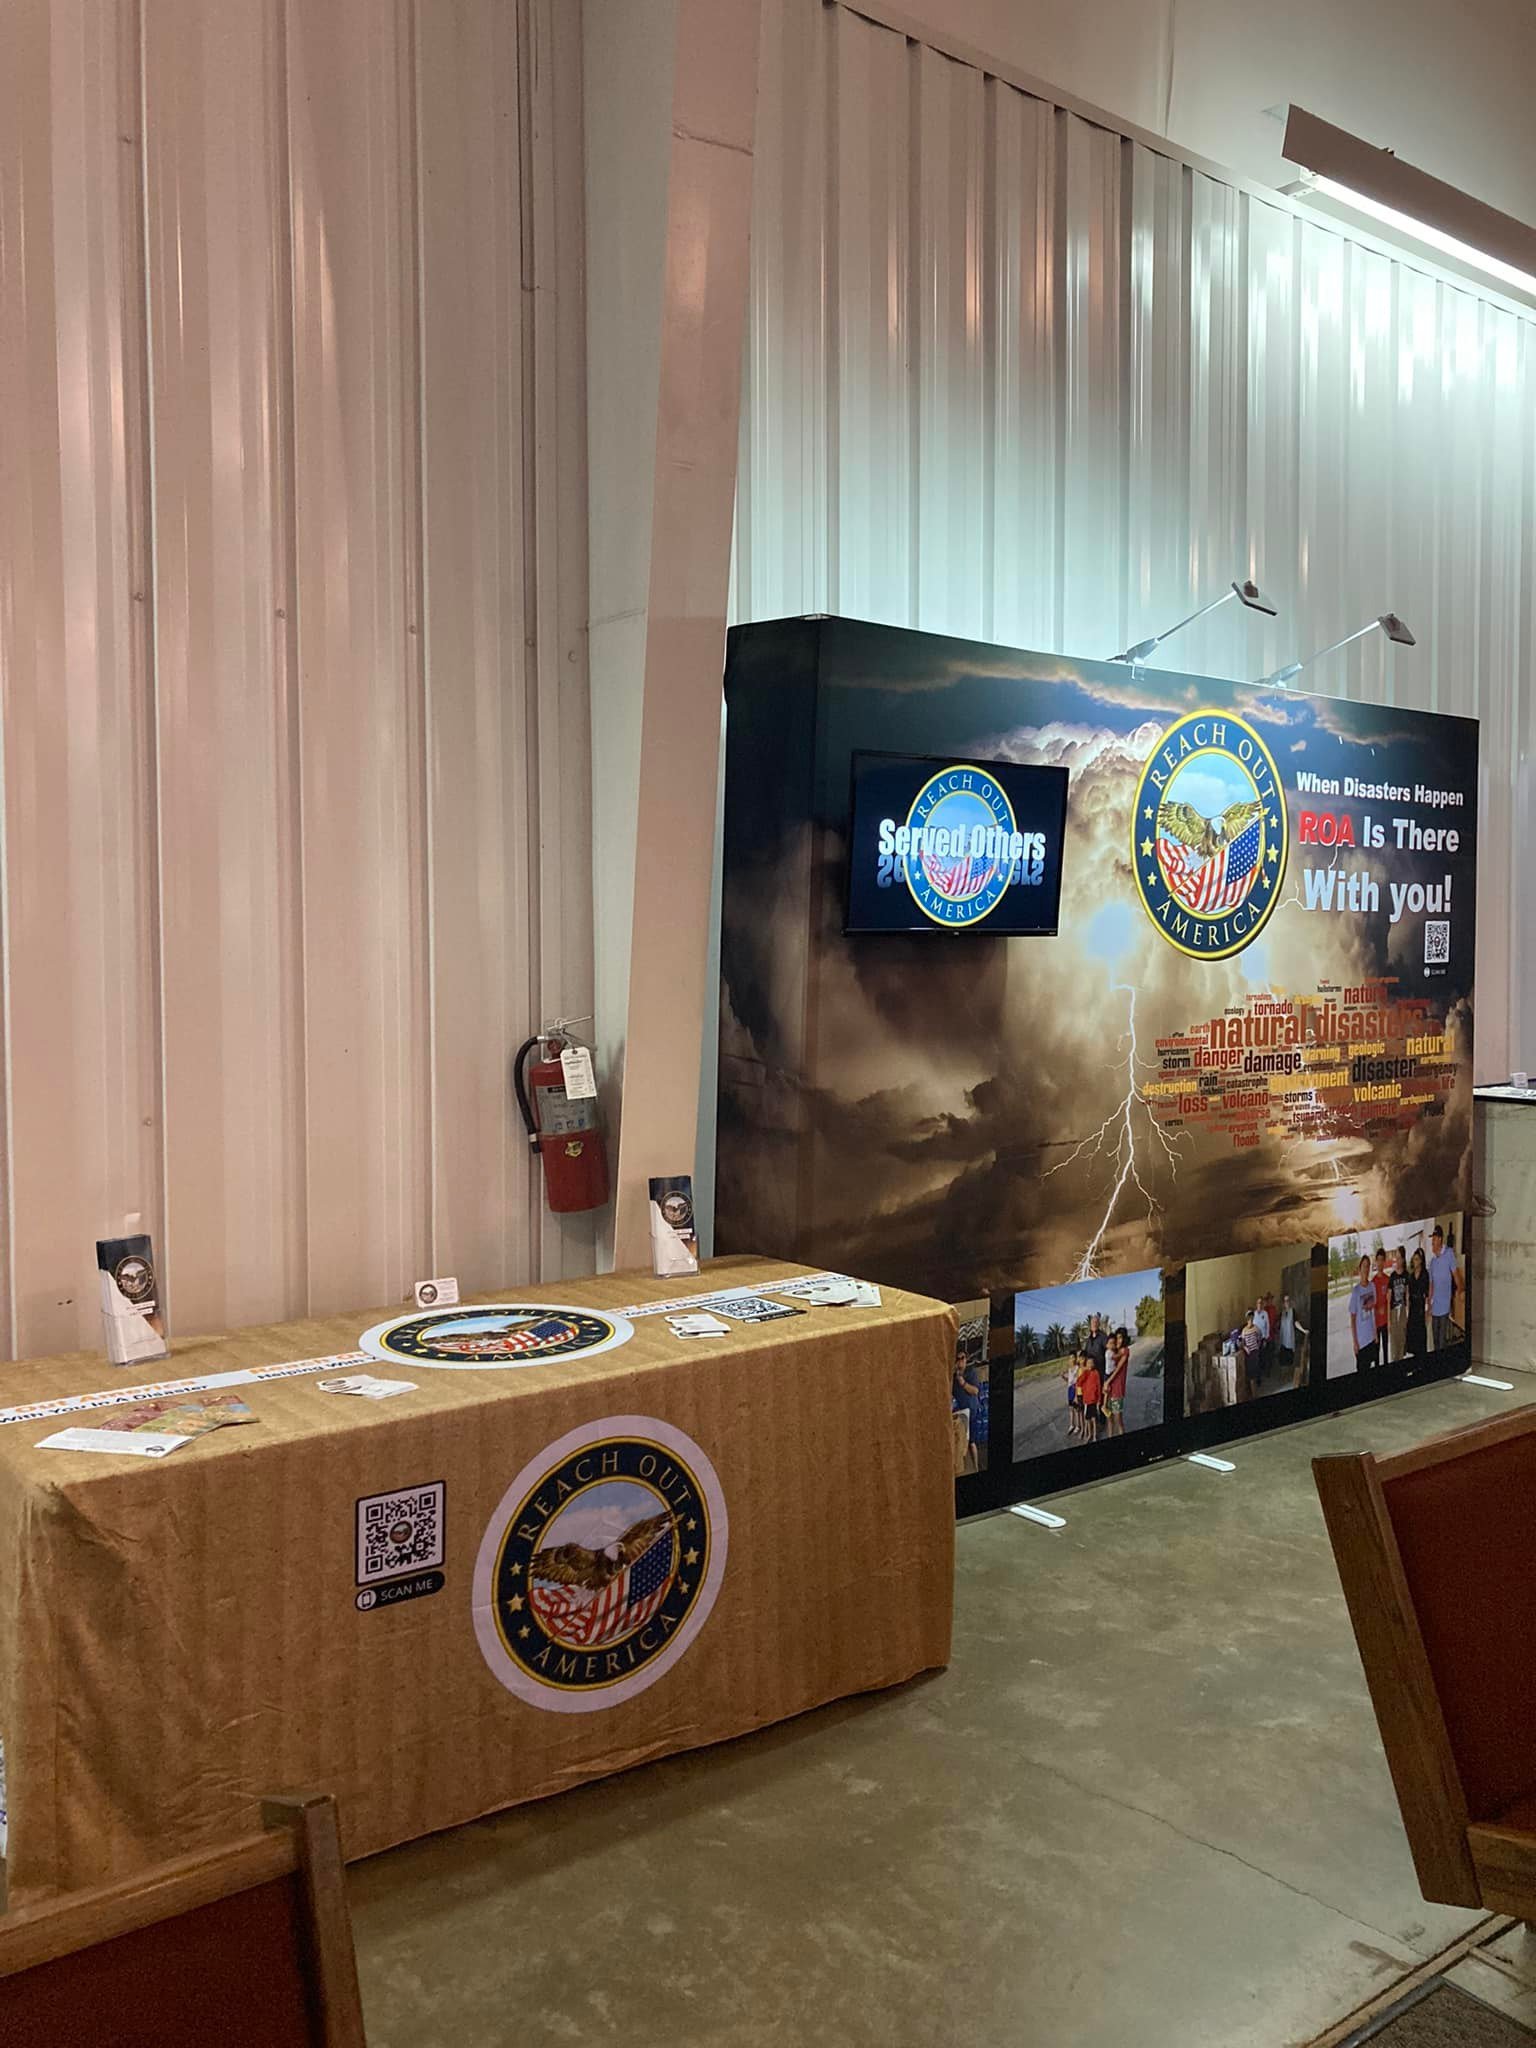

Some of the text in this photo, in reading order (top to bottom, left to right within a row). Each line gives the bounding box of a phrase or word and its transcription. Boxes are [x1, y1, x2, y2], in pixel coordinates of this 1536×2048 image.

[1151, 723, 1277, 799] REACH OUT
[917, 774, 1008, 823] REACH OUT
[1297, 771, 1464, 808] When Disasters Happen
[878, 818, 1046, 861] Served Others
[1299, 811, 1459, 852] ROA Is There
[920, 888, 996, 919] AMERICA
[1303, 869, 1452, 923] With you!
[1157, 900, 1262, 946] AMERICA
[1254, 999, 1293, 1016] tornado
[1211, 1002, 1306, 1049] natural
[1348, 1040, 1385, 1060] geologic
[1406, 1032, 1455, 1056] natural
[1163, 1057, 1190, 1069] storm
[1194, 1046, 1244, 1070] danger
[1244, 1050, 1301, 1075] damage
[1352, 1055, 1417, 1082] disaster
[1142, 1079, 1198, 1096] destruction
[1199, 1073, 1218, 1087] rain
[1354, 1079, 1402, 1103] volcanic
[1178, 1092, 1208, 1114] loss
[1222, 1089, 1269, 1110] volcano
[1283, 1091, 1313, 1104] storms
[257, 1365, 324, 1379] Helping
[48, 1404, 89, 1414] You
[132, 1384, 209, 1401] Disaster
[517, 1451, 692, 1543] REACH OUT
[380, 1578, 433, 1601] SCAN ME
[532, 1613, 679, 1680] AMERICA
